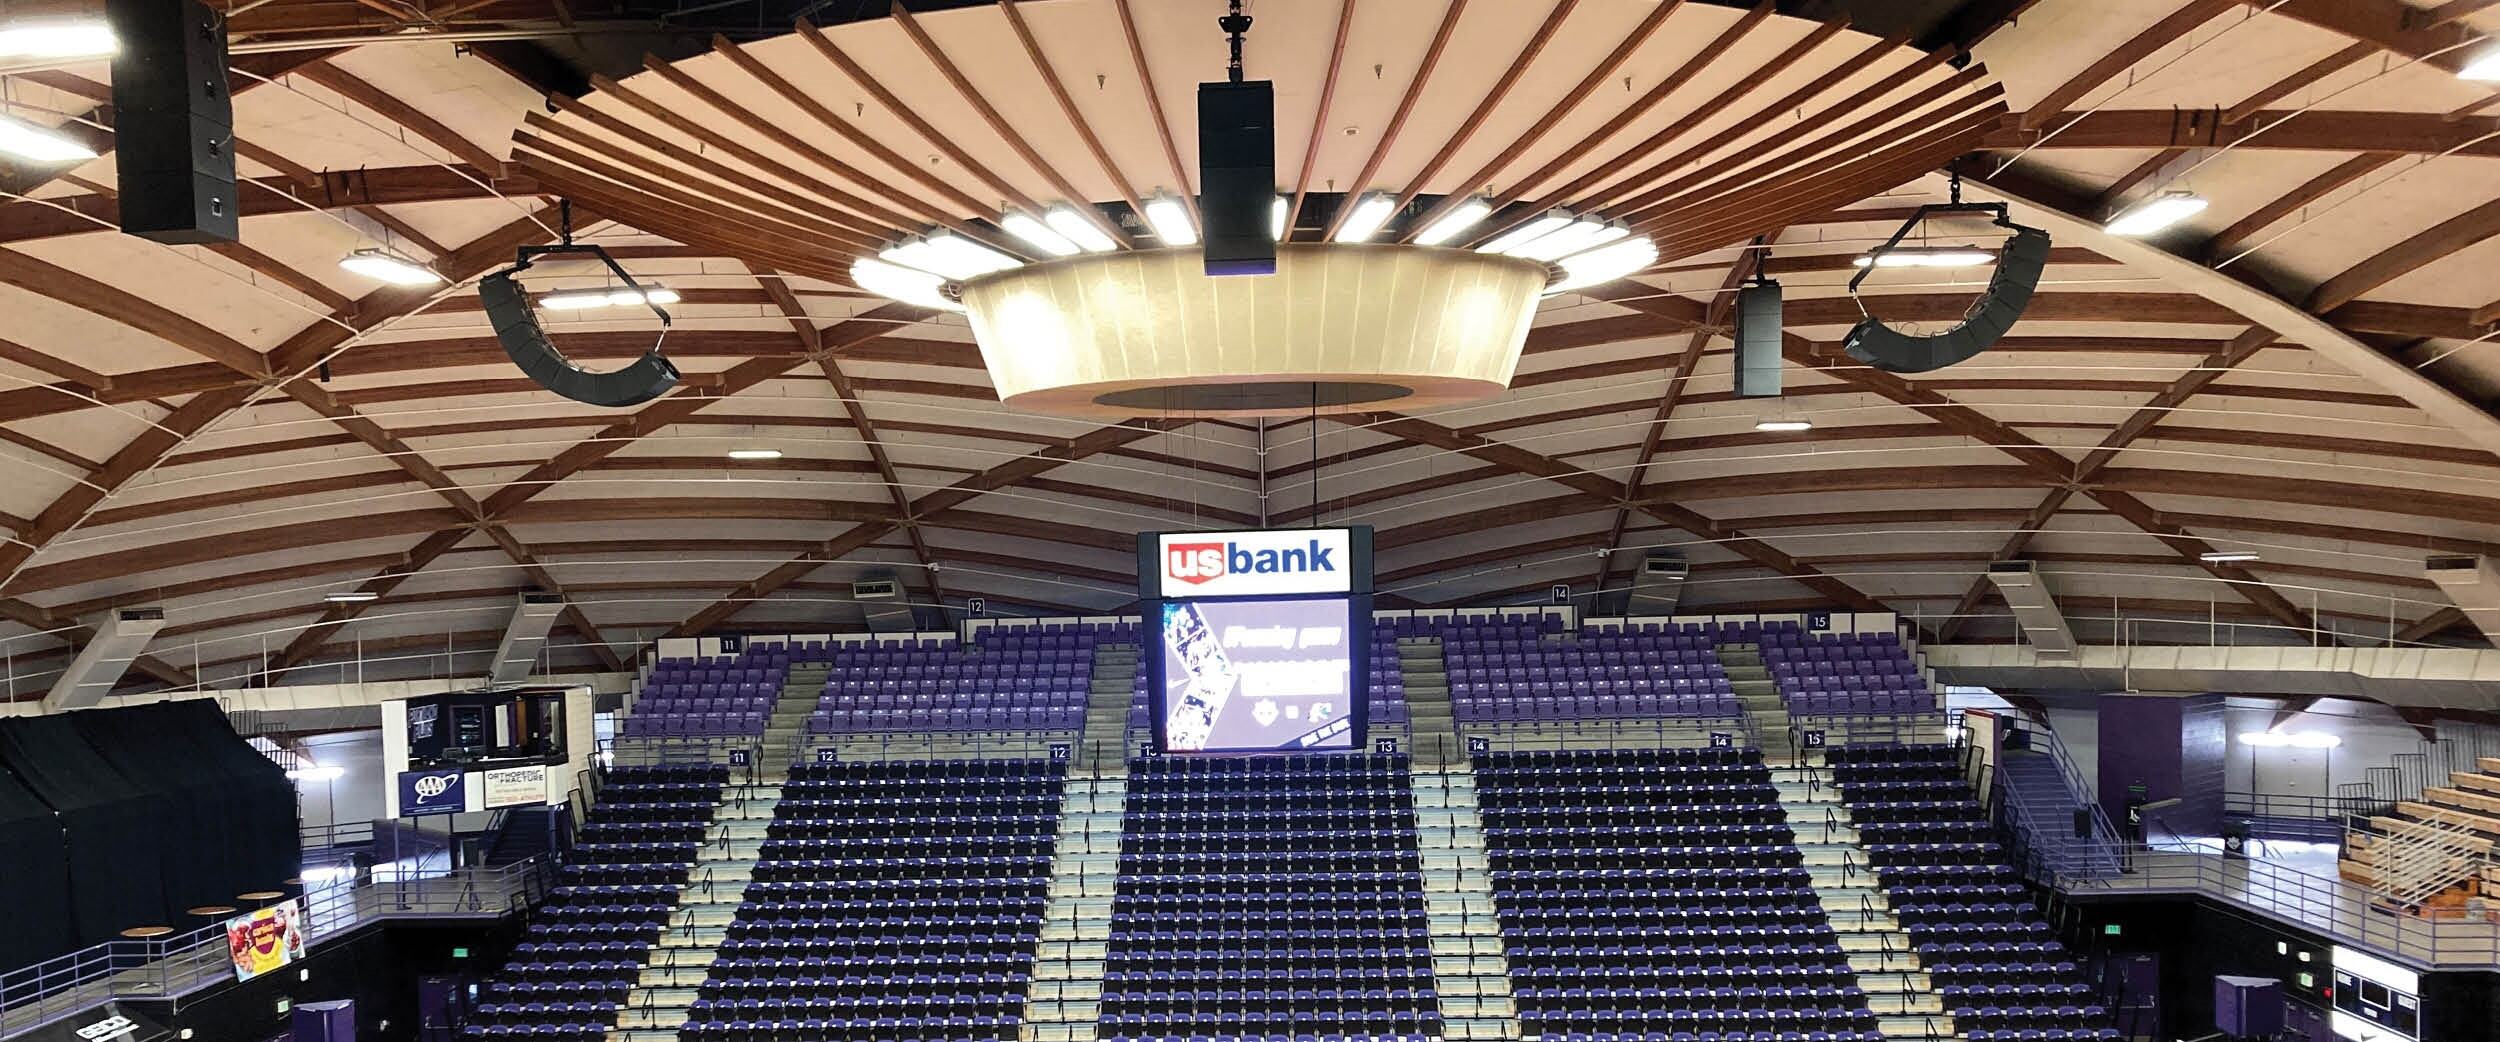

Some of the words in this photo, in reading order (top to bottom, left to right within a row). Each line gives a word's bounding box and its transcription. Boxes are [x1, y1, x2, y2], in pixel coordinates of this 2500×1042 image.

[1555, 588, 1566, 599] 14
[971, 601, 982, 612] 12
[1815, 616, 1826, 627] 15
[725, 639, 734, 650] 11
[1473, 739, 1484, 750] 14
[1715, 736, 1727, 747] 14
[1808, 734, 1820, 745] 15
[1053, 747, 1065, 758] 12
[1380, 742, 1392, 753] 13
[734, 753, 744, 763] 11
[821, 751, 833, 762] 12
[418, 777, 444, 795] AAA
